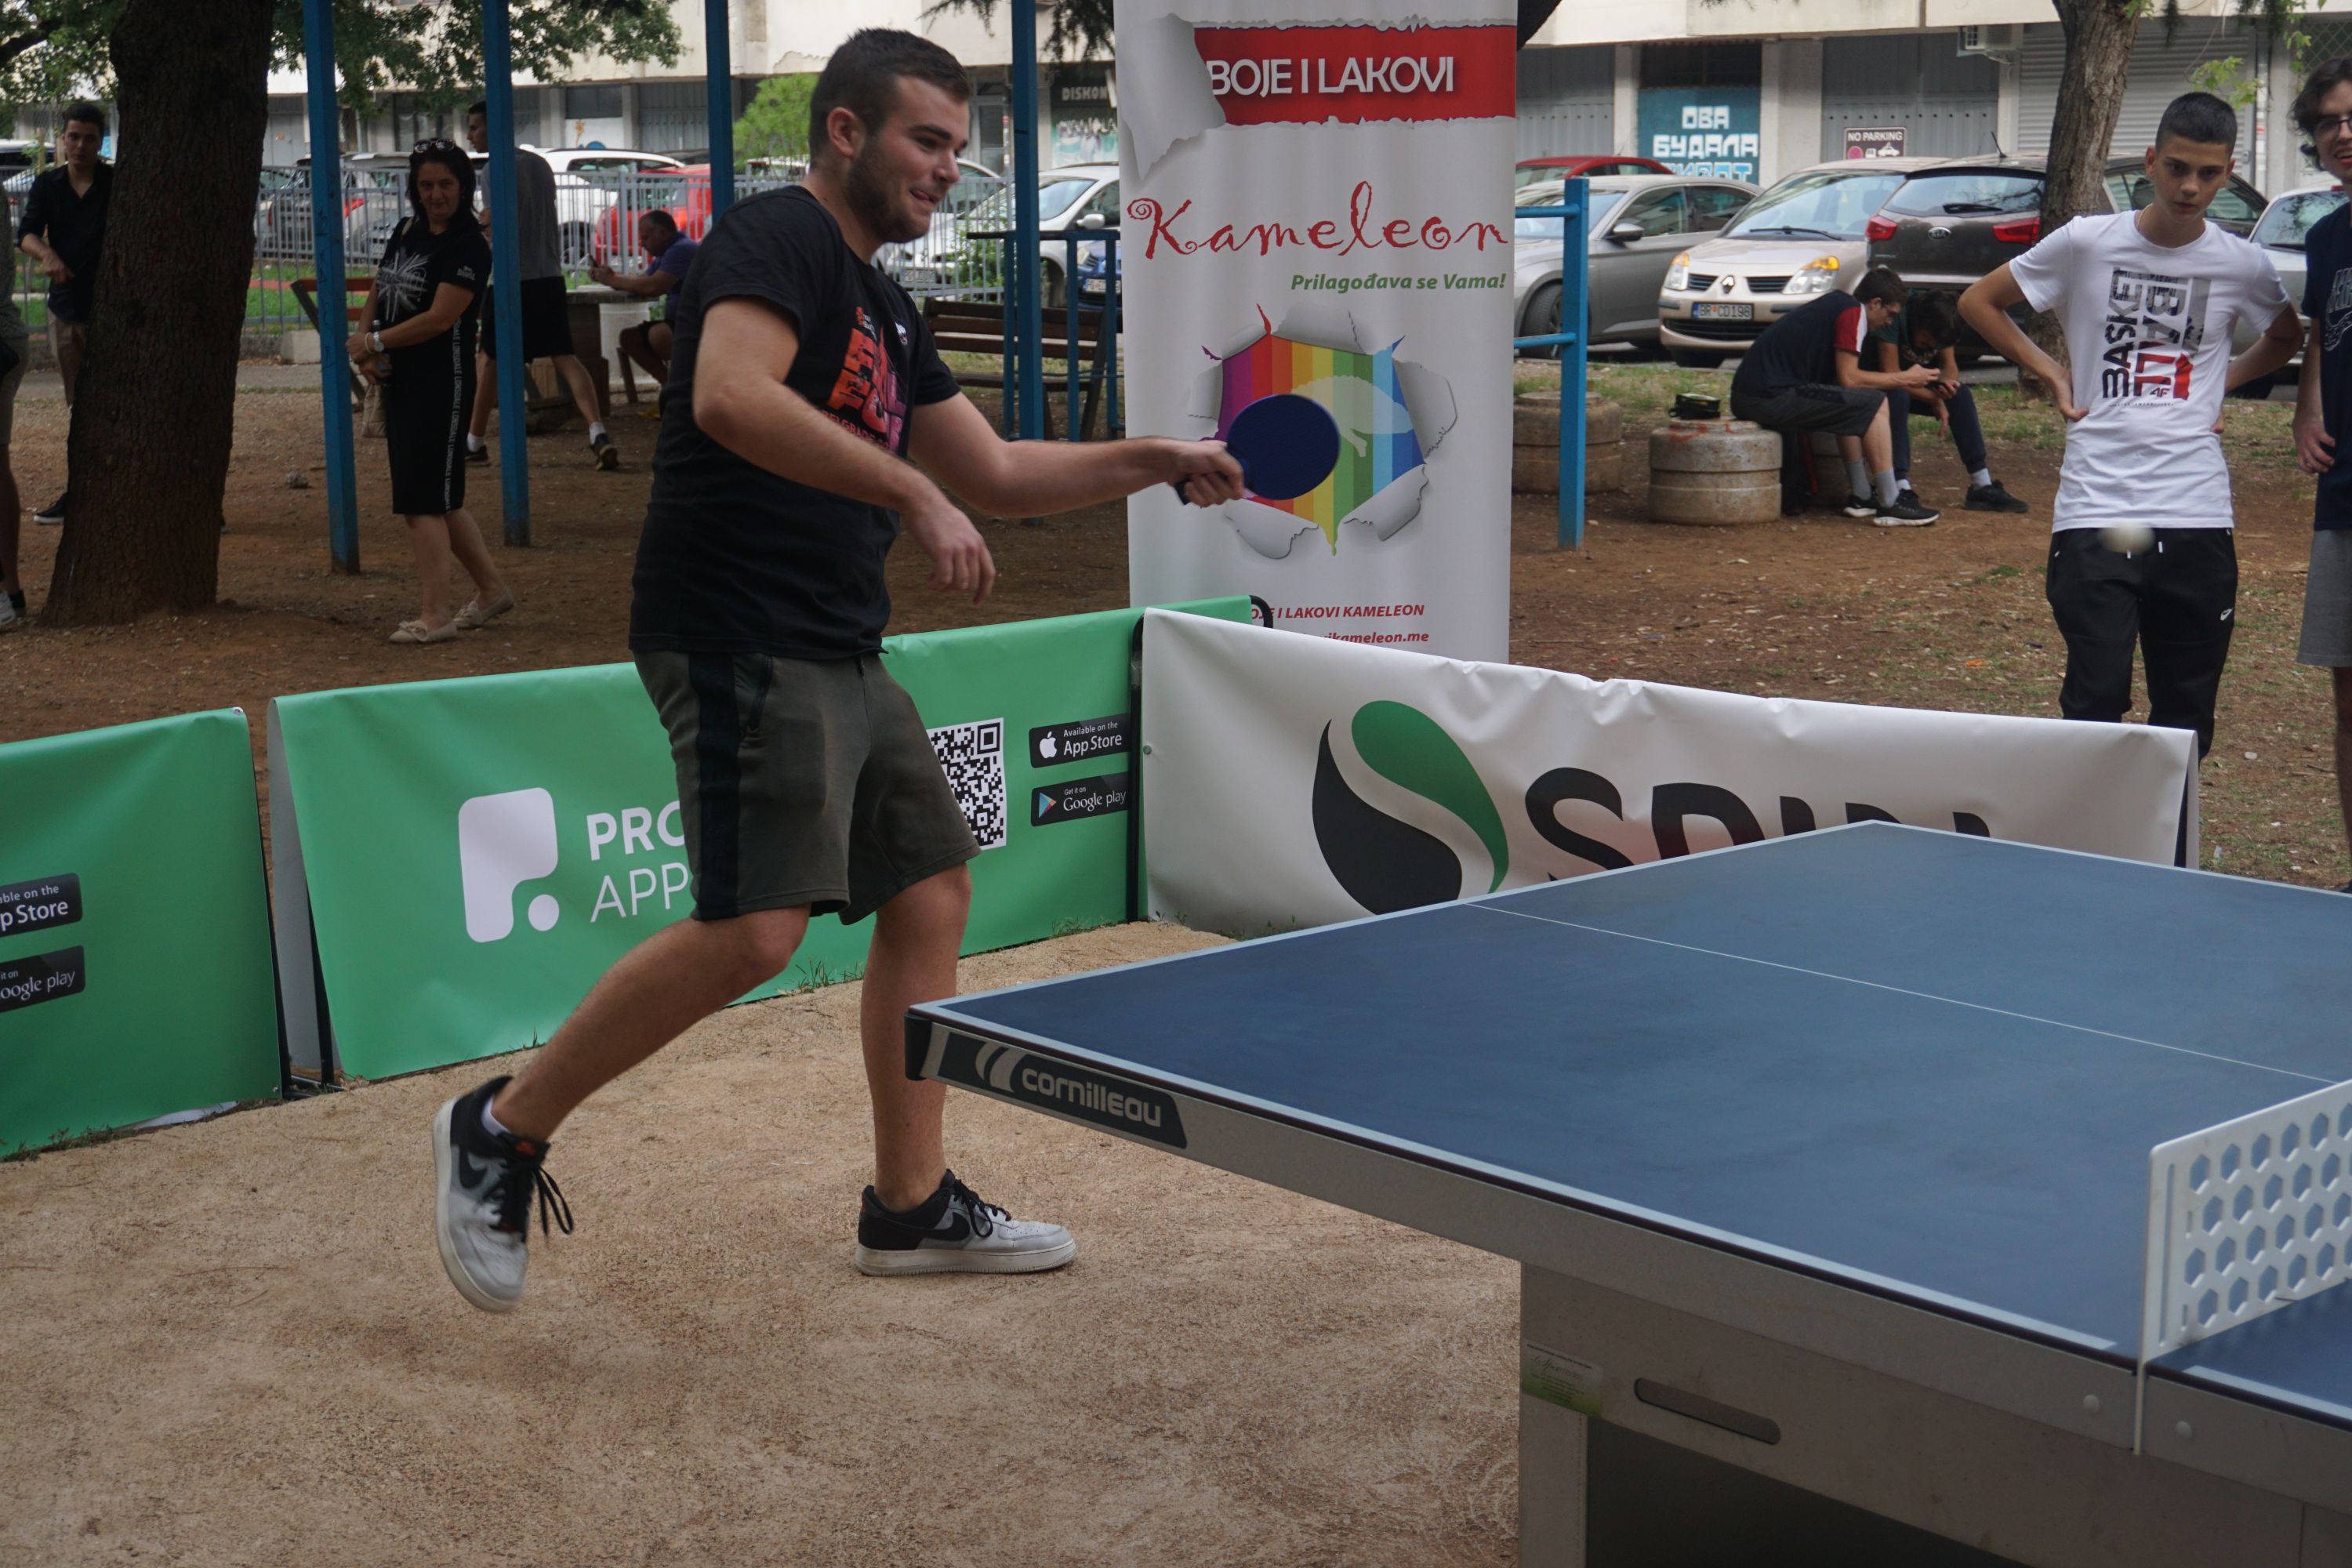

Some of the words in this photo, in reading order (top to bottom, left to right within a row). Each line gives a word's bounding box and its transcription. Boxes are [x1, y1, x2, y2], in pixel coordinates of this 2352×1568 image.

[1207, 59, 1292, 97] BOJE
[1301, 58, 1308, 93] I
[1318, 56, 1454, 93] LAKOVI
[1682, 105, 1730, 129] ОВА
[1653, 133, 1759, 159] БУДАЛА
[1847, 132, 1861, 141] NO
[1862, 131, 1903, 141] PARKING
[1127, 180, 1508, 260] Kameleon
[1290, 273, 1411, 294] Prilagođava
[1416, 278, 1436, 290] se
[1443, 273, 1506, 290] Vama!
[2103, 267, 2143, 398] BASKET
[452, 342, 463, 375] LONSDALE
[452, 376, 463, 409] LONSDALE
[2149, 387, 2170, 397] 4F
[448, 410, 461, 443] LONSDALE
[1277, 608, 1283, 619] I
[1285, 606, 1340, 619] LAKOVI
[1343, 604, 1425, 617] KAMELEON
[1063, 725, 1096, 738] Available
[1107, 721, 1118, 730] the
[1063, 740, 1089, 757] App
[1090, 735, 1123, 750] Store
[1063, 792, 1102, 811] Google
[1106, 790, 1127, 808] play
[1064, 787, 1073, 796] Get
[24, 889, 38, 899] on
[41, 884, 60, 896] the
[590, 862, 688, 923] APP
[16, 901, 69, 924] Store
[0, 977, 42, 1000] oogle
[47, 971, 75, 993] play
[8, 970, 19, 979] on
[1022, 1068, 1161, 1128] cornilleau
